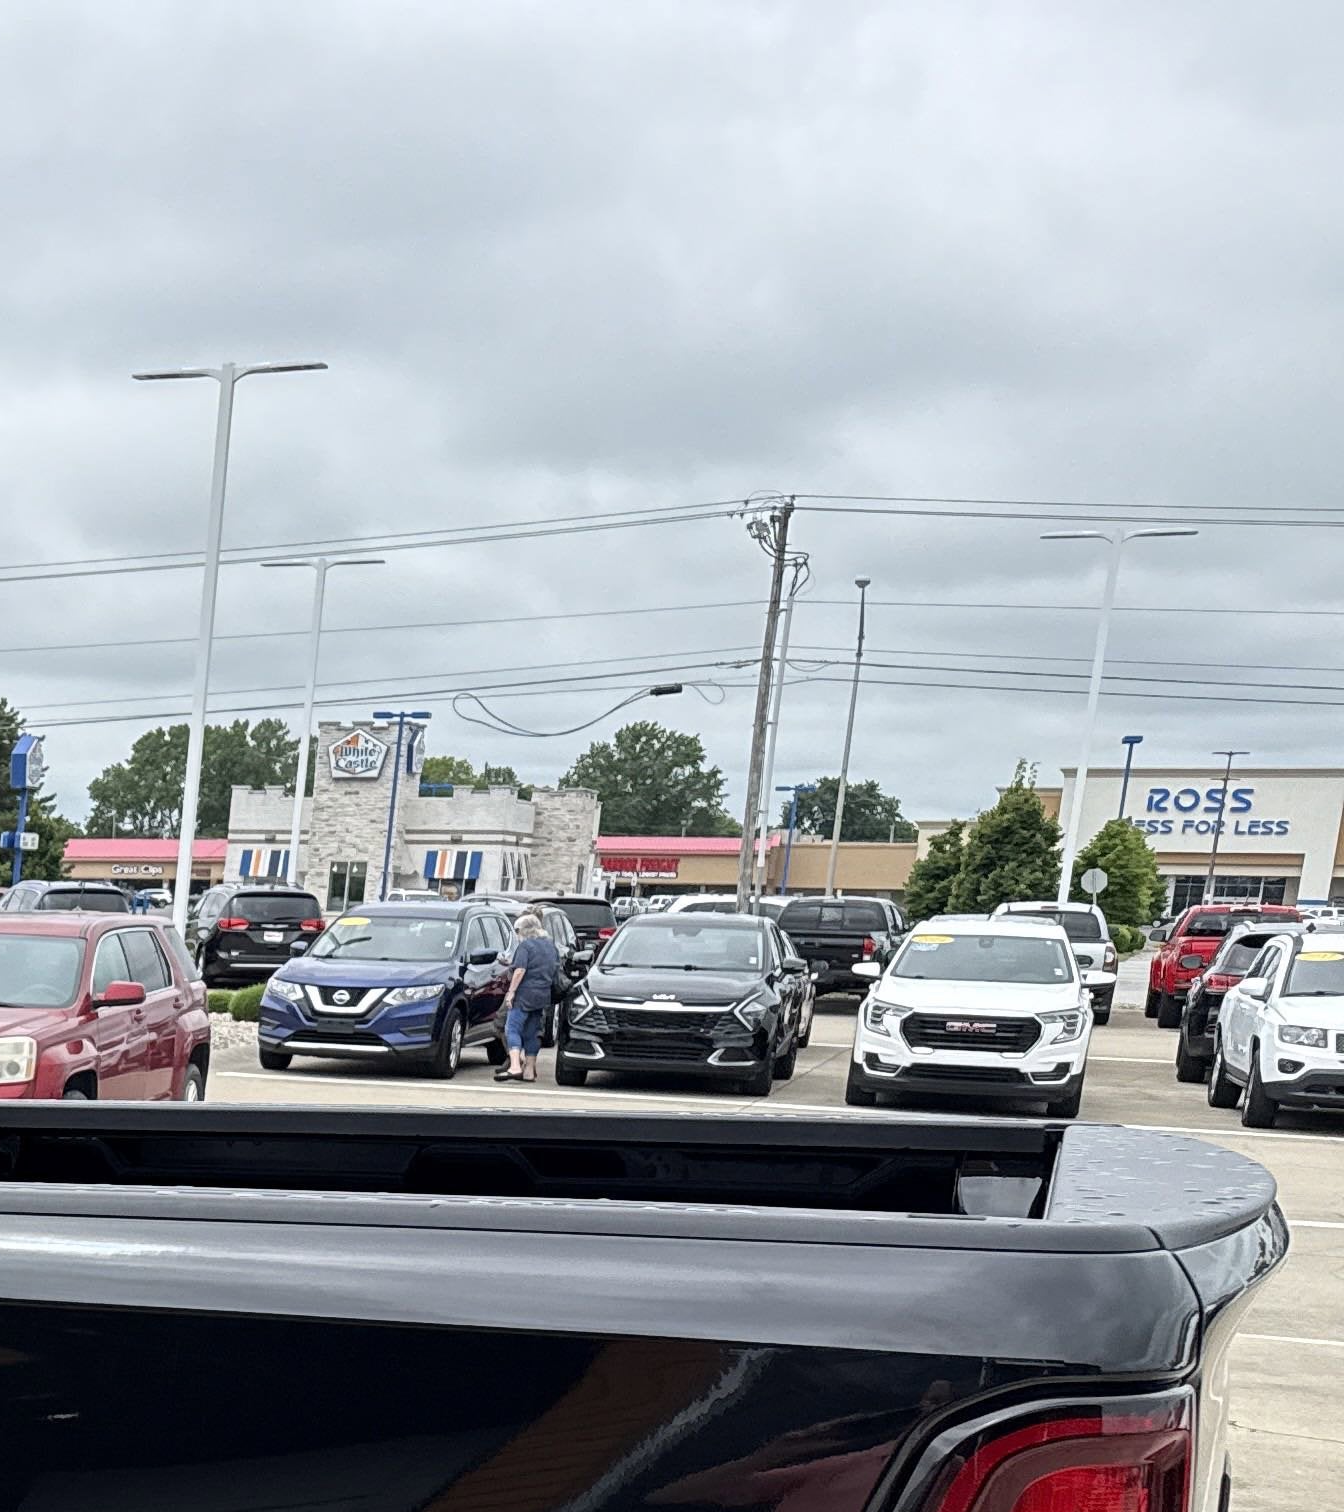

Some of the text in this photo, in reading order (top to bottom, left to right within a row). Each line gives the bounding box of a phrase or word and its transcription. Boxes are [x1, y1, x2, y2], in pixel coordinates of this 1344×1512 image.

[340, 745, 377, 758] White
[335, 758, 377, 769] Castle
[1146, 788, 1255, 813] ROSS
[1133, 819, 1289, 836] ESS FOR LESS
[111, 864, 164, 876] Great Clips
